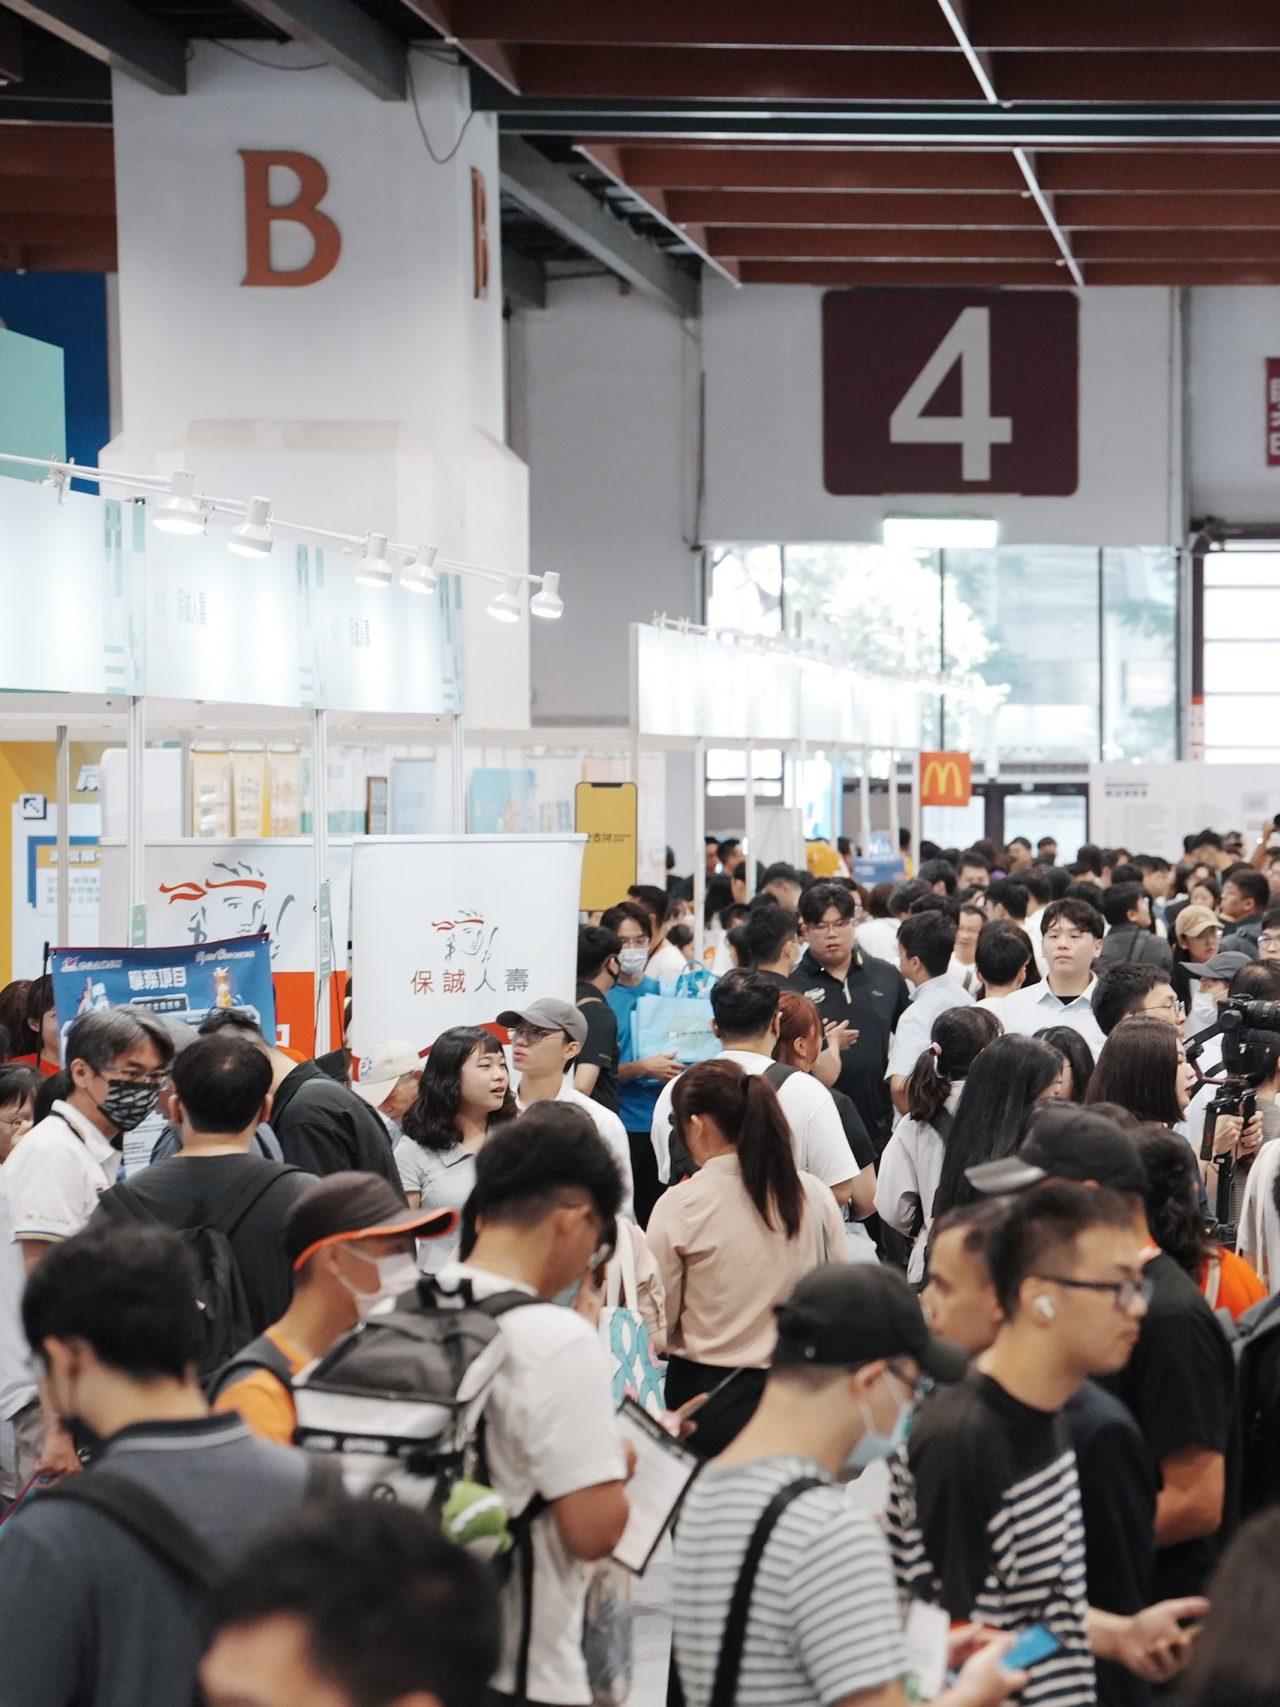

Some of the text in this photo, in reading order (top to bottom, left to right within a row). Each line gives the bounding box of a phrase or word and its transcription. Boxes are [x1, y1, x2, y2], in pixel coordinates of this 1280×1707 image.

[238, 149, 342, 286] B
[471, 166, 488, 299] B
[889, 306, 1012, 481] 4
[410, 967, 529, 995] 保誠人壽
